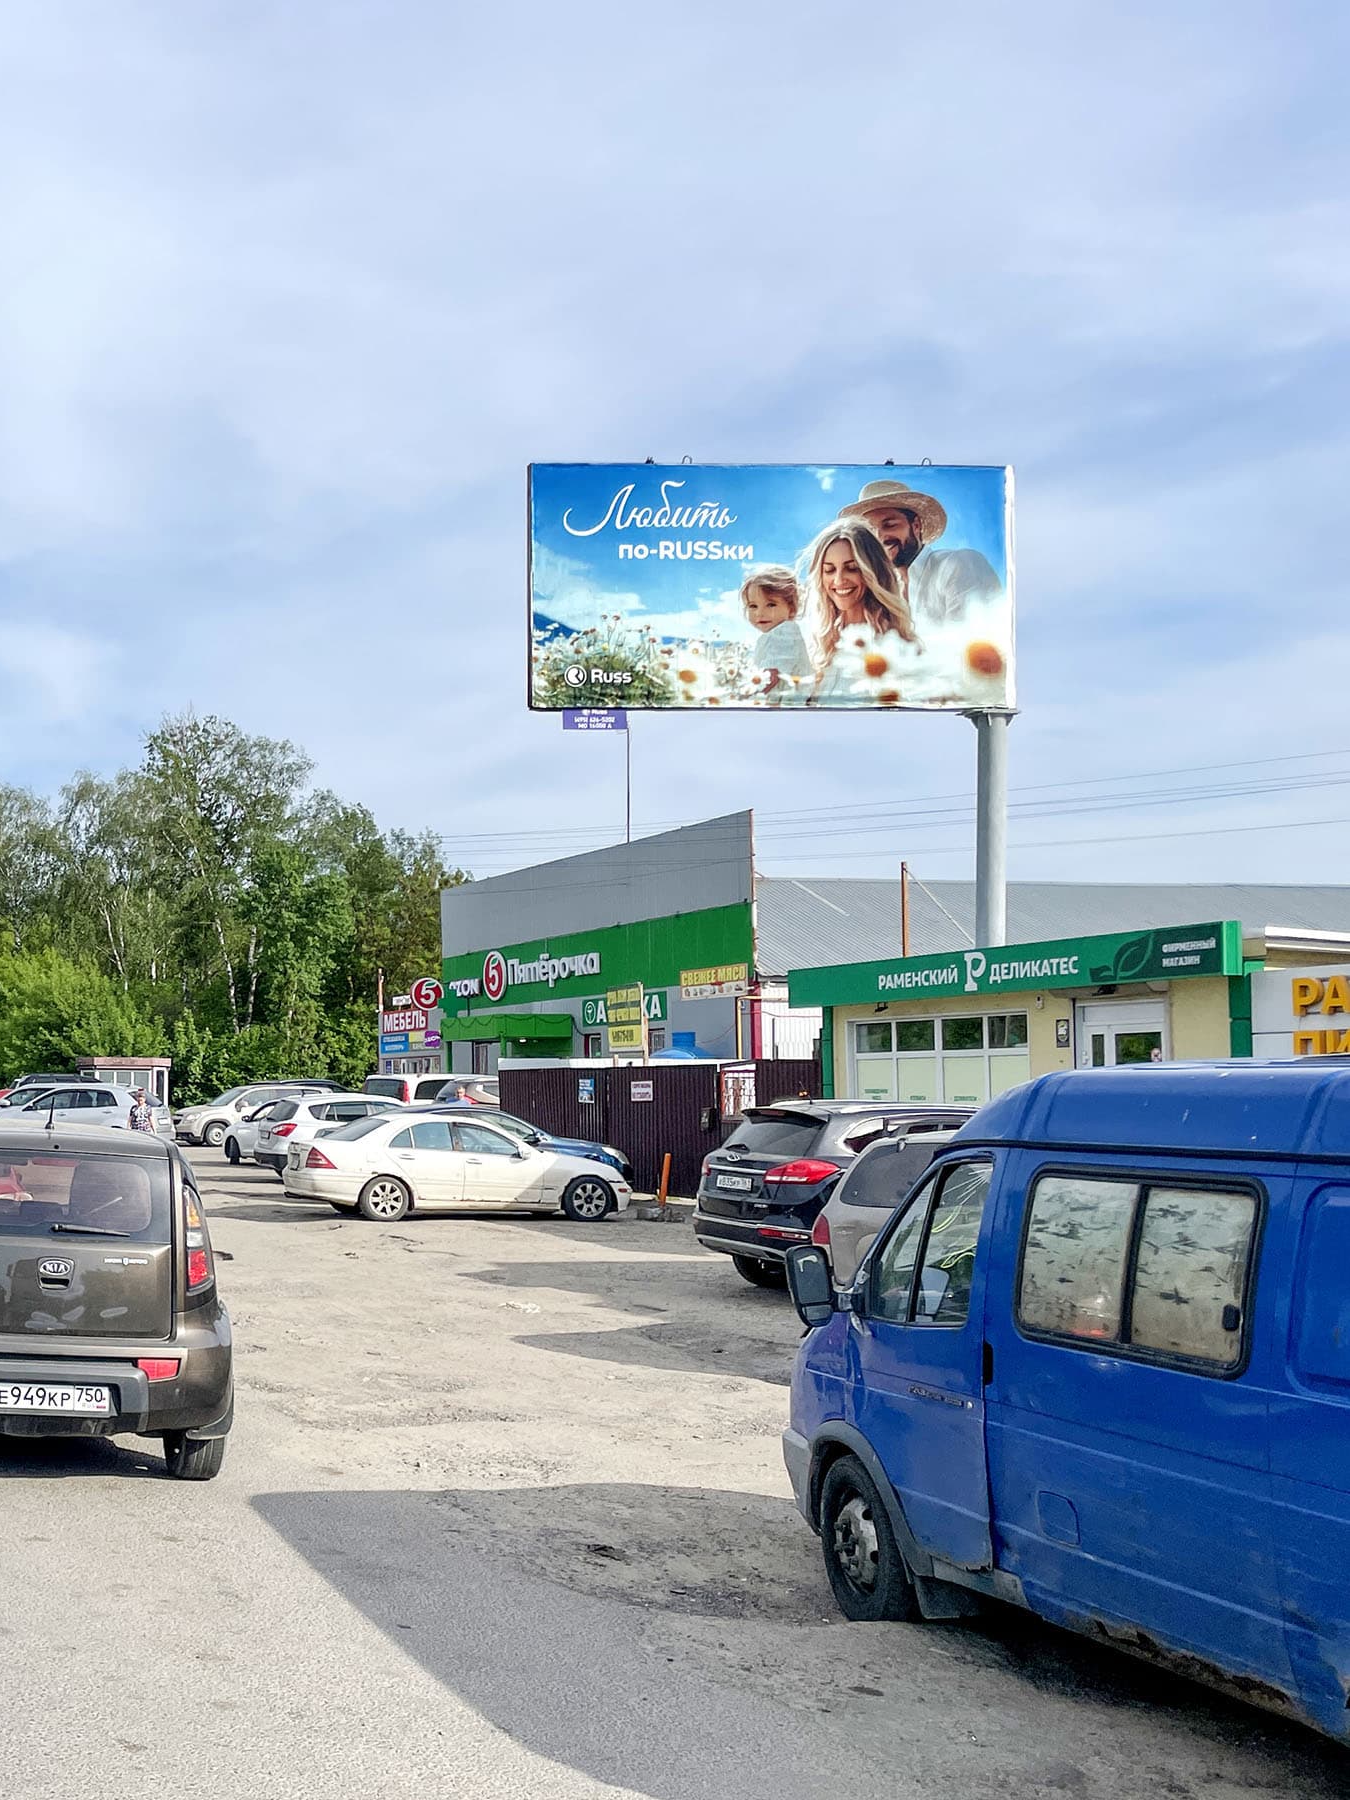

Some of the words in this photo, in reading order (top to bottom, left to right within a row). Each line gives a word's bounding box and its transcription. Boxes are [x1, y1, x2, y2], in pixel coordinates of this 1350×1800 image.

[562, 480, 738, 537] Любить
[618, 541, 754, 560] по-RUSSки
[590, 669, 633, 684] Russ
[1162, 937, 1216, 953] ФИРМЕННЫЙ
[507, 952, 600, 987] Пятёрочка
[1162, 955, 1201, 968] МАГАЗИН
[681, 970, 716, 986] СВЕЖЕЕ
[717, 966, 746, 981] МЯСО
[878, 964, 958, 990] РАМЕНСКИЙ
[989, 956, 1079, 984] ДЕЛИКАТЕС
[383, 1010, 427, 1033] МЕБЕЛЬ
[43, 1262, 68, 1274] KIA
[76, 1387, 103, 1403] 750
